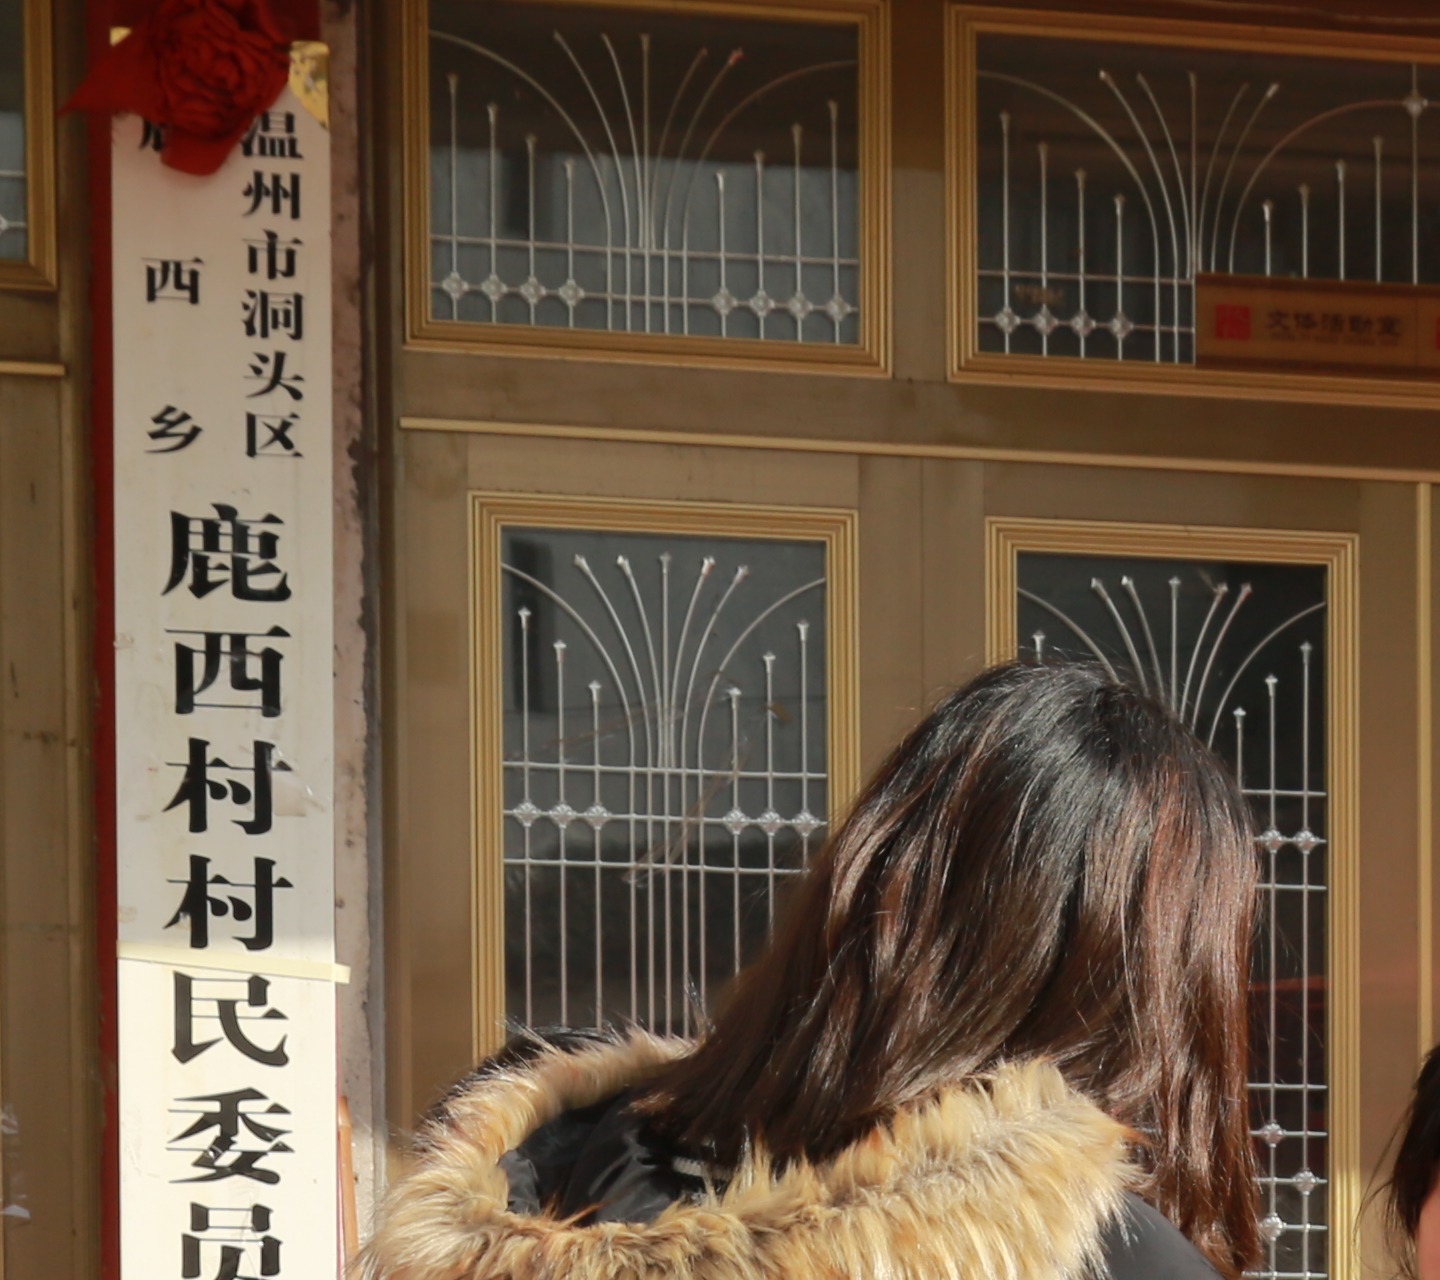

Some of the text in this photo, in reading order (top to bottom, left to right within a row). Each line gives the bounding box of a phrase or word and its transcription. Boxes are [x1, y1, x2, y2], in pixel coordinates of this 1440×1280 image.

[240, 110, 305, 459] 温州市洞头区
